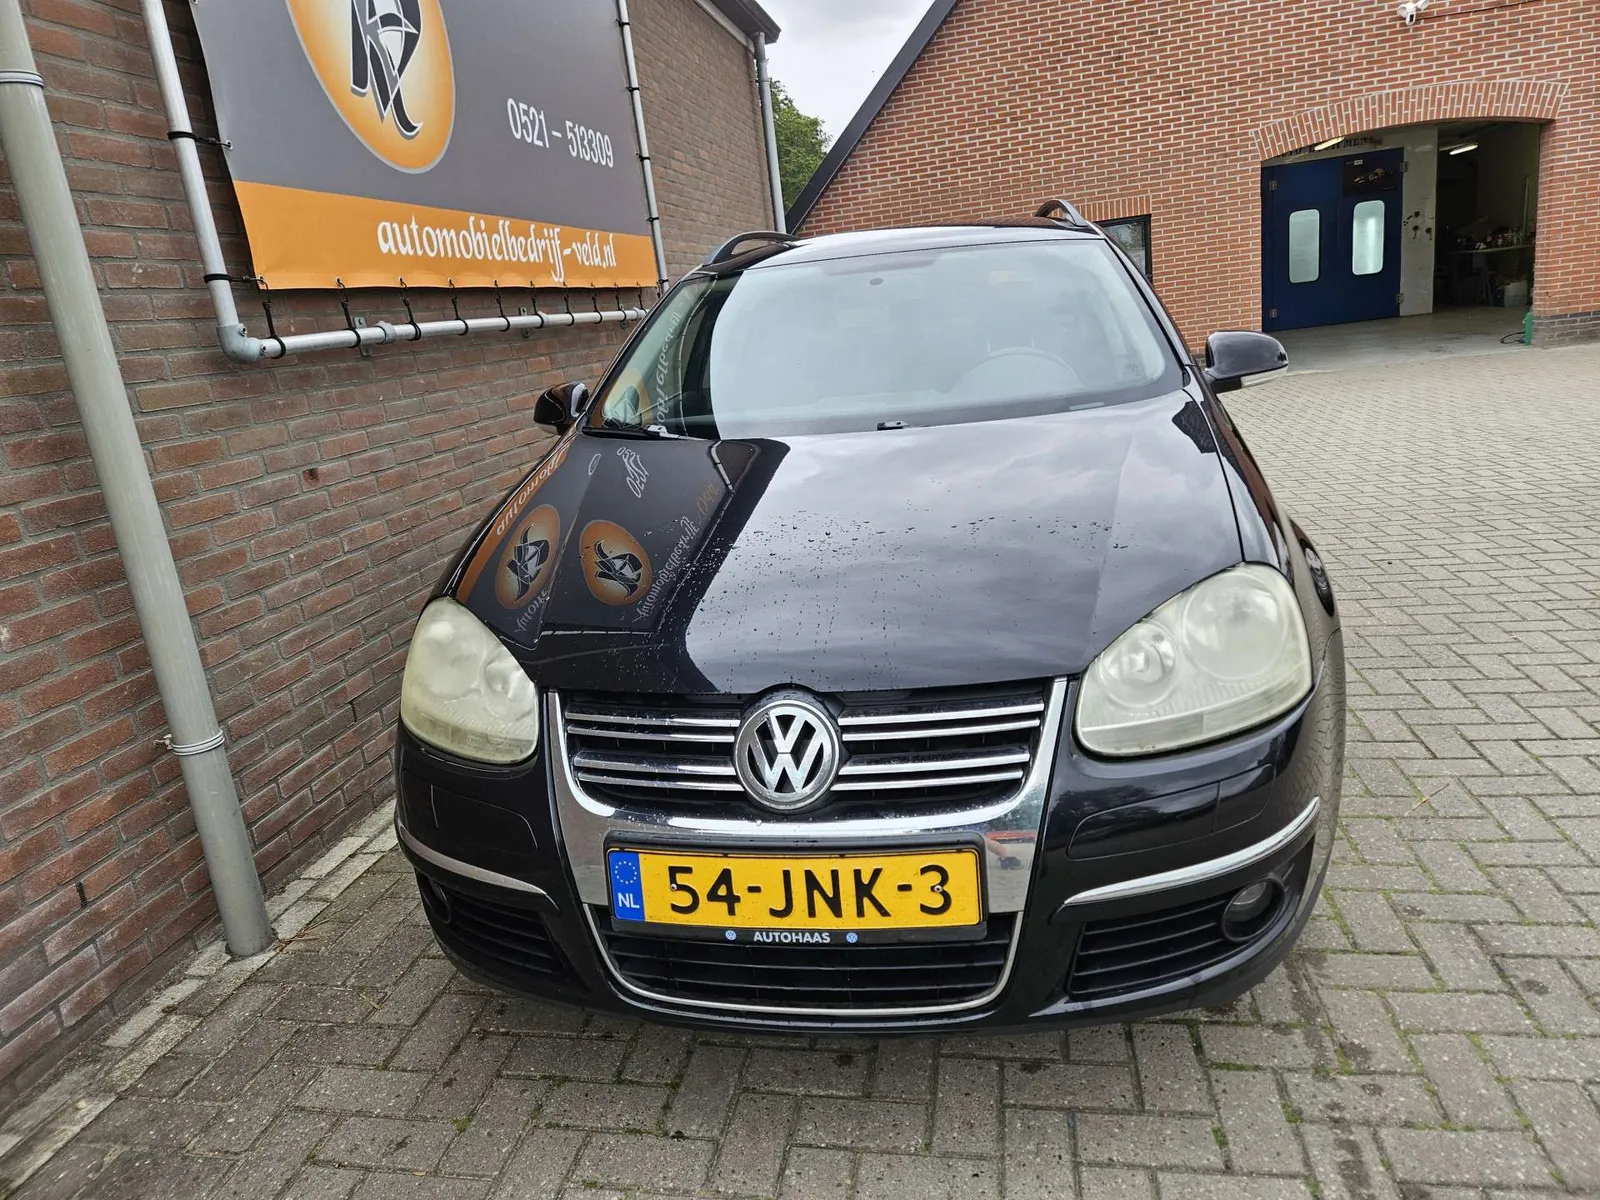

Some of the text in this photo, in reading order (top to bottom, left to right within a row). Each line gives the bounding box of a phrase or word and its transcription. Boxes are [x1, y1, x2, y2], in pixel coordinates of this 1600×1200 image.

[507, 98, 549, 149] 0521
[565, 120, 613, 168] 513309
[377, 214, 617, 282] automobielbedrijf-veld.nl
[742, 703, 832, 801] VW
[618, 864, 952, 919] NL 54-JNK-3
[753, 931, 831, 943] AUTOHAAS
